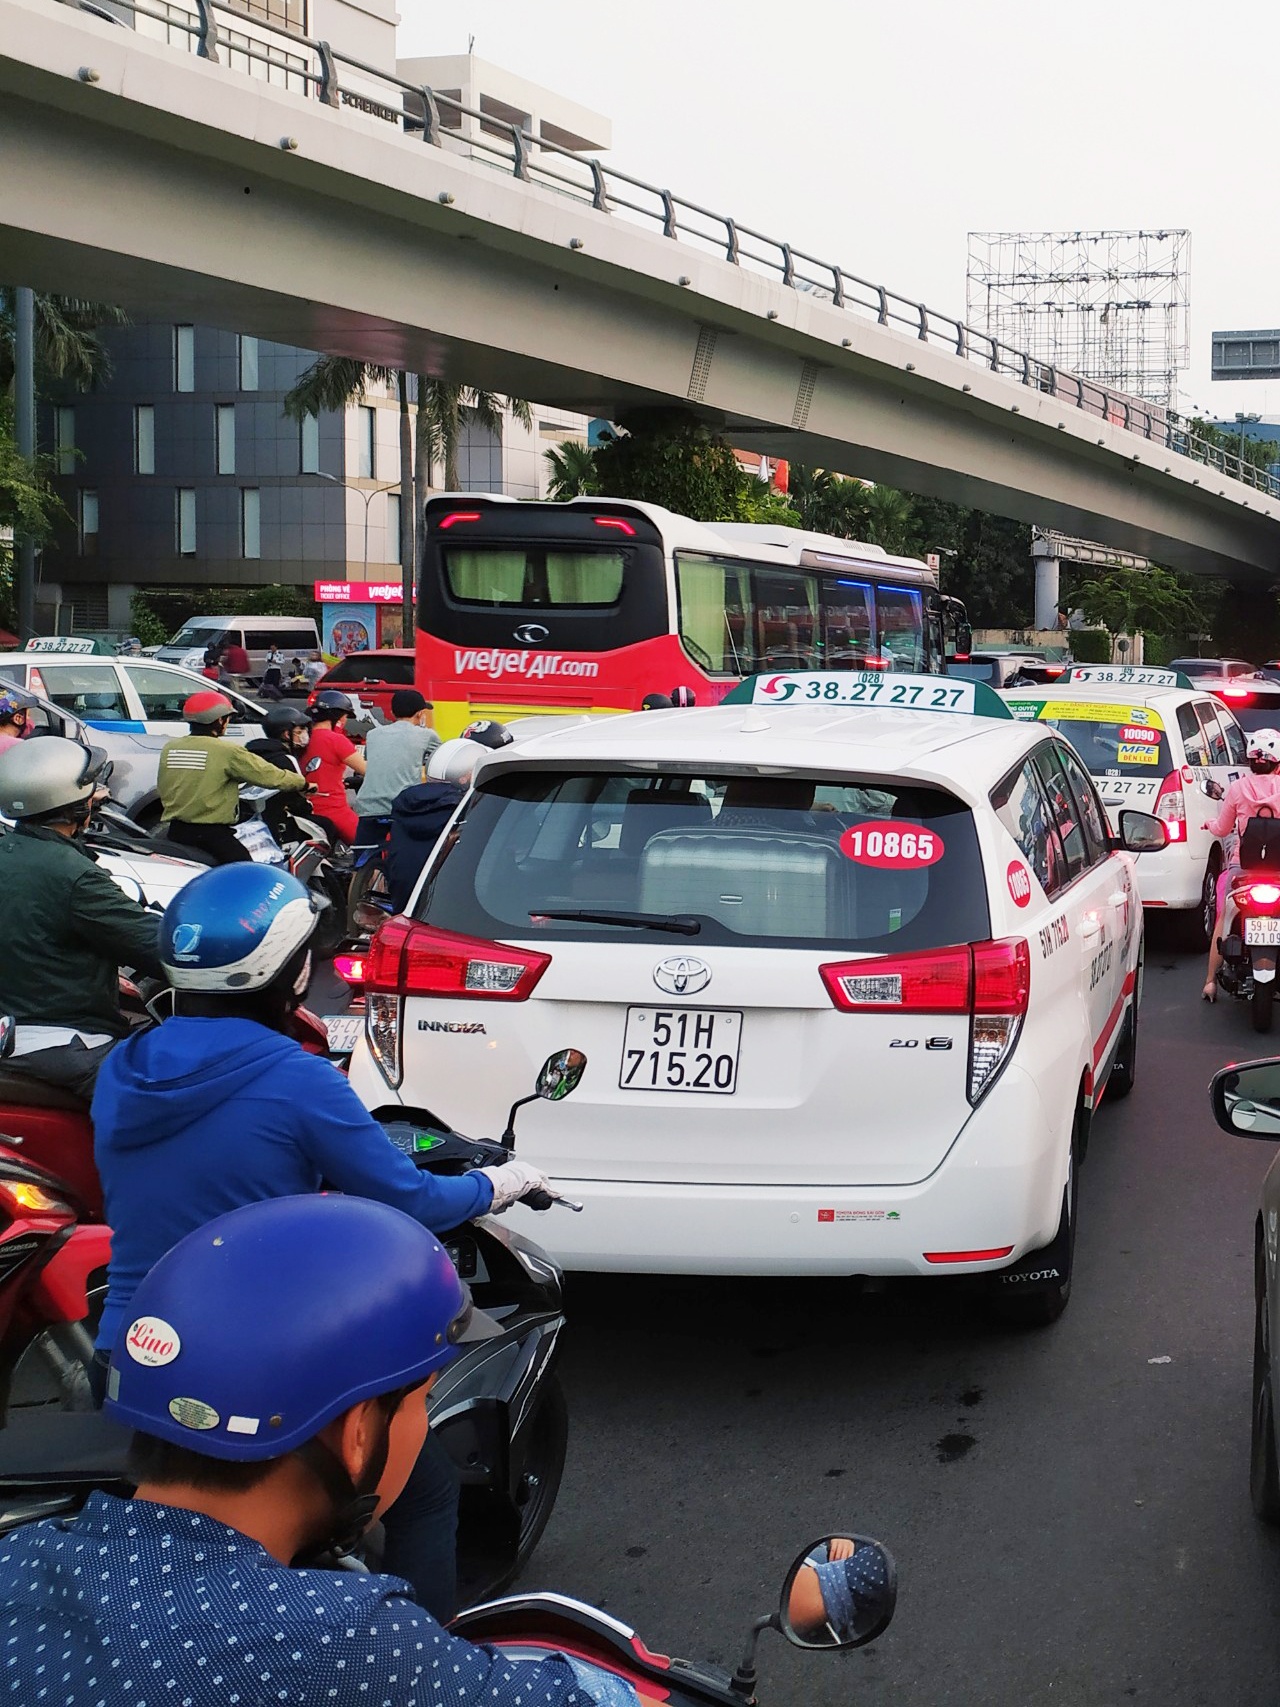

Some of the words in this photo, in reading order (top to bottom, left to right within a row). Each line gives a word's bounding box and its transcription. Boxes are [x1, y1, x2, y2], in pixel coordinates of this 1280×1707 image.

[341, 91, 398, 125] SCHENKER
[67, 643, 78, 651] 27
[79, 644, 91, 652] 27
[857, 672, 884, 684] (028)
[1097, 672, 1133, 682] 38.27
[1138, 673, 1155, 683] 27
[1157, 675, 1174, 685] 27
[805, 681, 883, 702] 38.27
[889, 685, 925, 705] 27
[930, 688, 965, 708] 27
[1123, 728, 1155, 742] 10090
[1120, 745, 1158, 755] MPE
[1114, 782, 1131, 793] 27
[1137, 783, 1156, 794] 27
[851, 831, 934, 860] 10865
[1008, 869, 1030, 900] 10865
[1251, 921, 1278, 931] 59-U2
[417, 1020, 487, 1035] INNOVA
[653, 1012, 715, 1049] 51H
[624, 1049, 733, 1089] 715.20
[1000, 1268, 1060, 1283] TOYOTA
[129, 1323, 173, 1356] Lino
